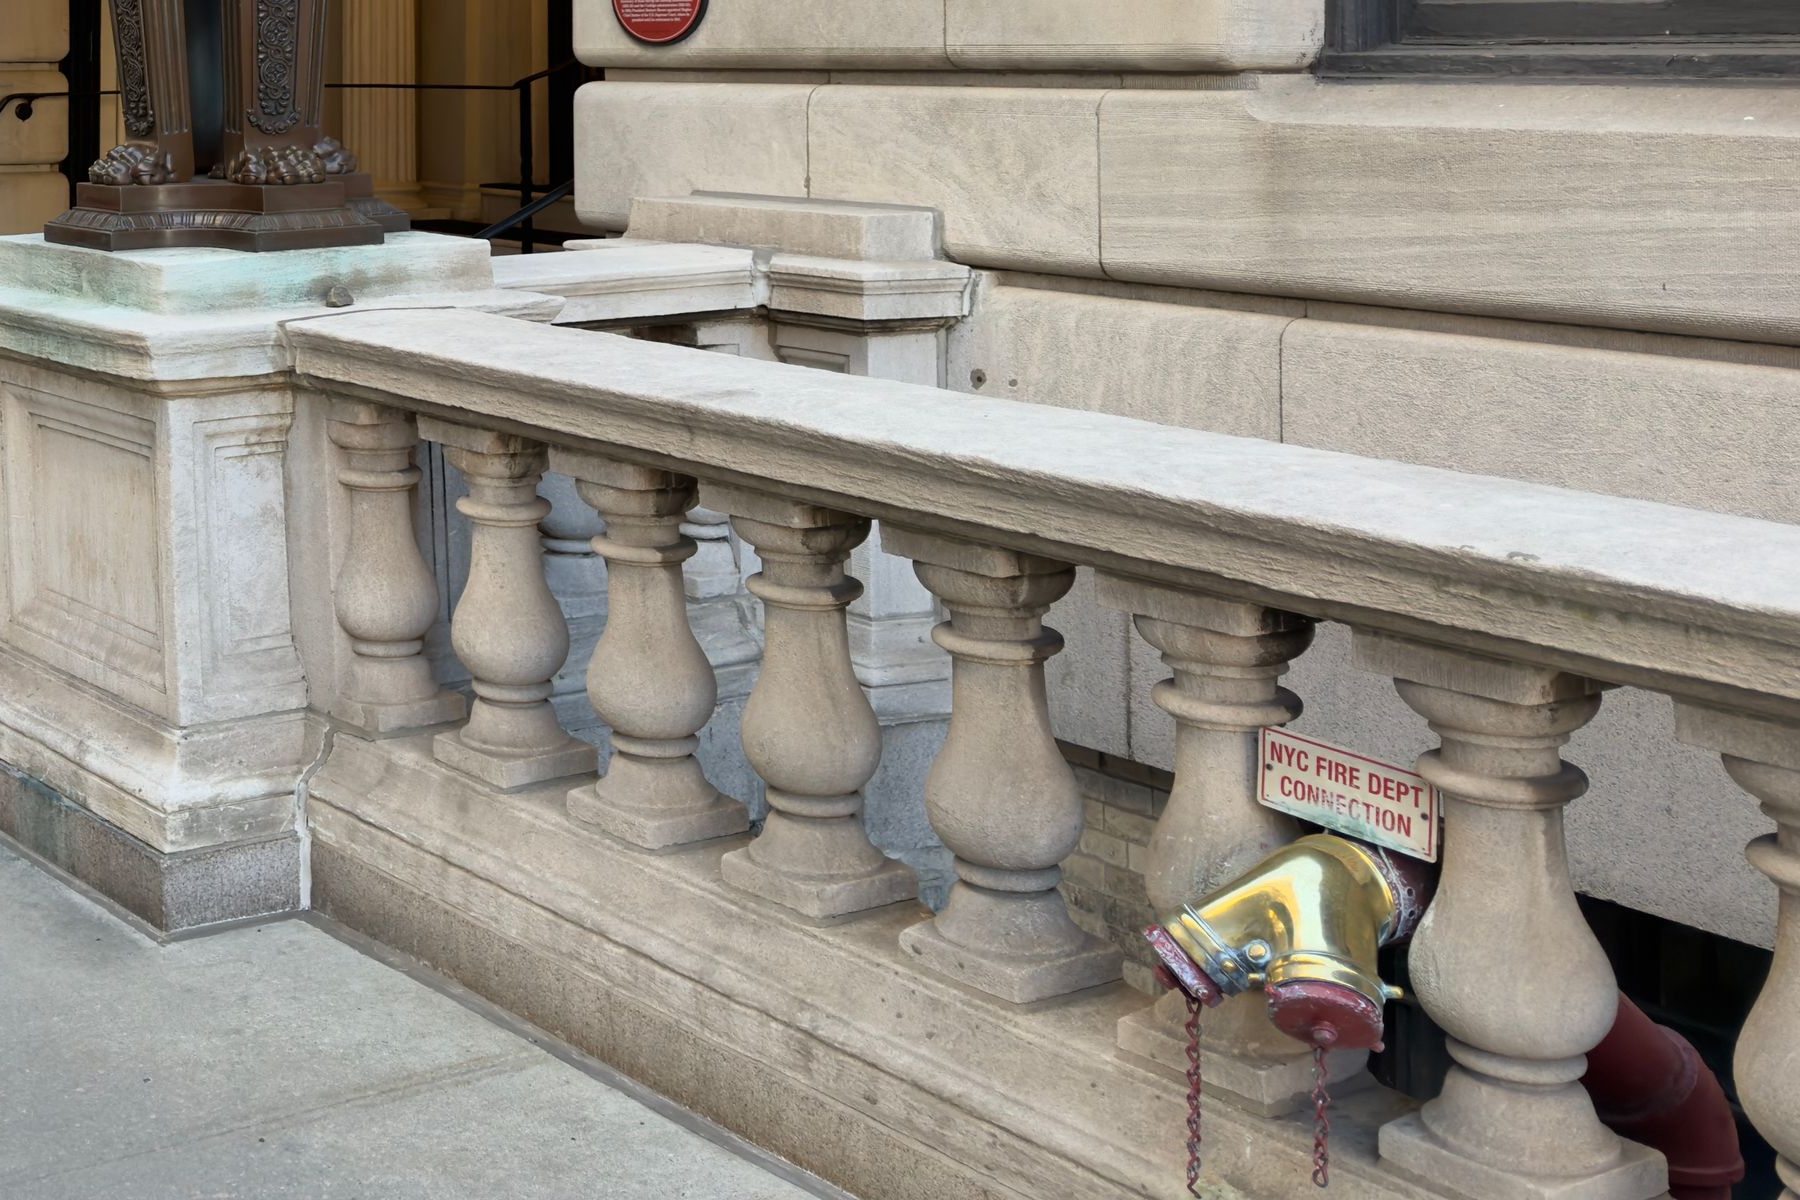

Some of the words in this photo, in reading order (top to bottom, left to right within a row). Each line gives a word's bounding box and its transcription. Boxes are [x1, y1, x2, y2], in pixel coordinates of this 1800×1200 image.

[1270, 741, 1309, 772] NYC
[1316, 756, 1361, 790] FIRE
[1368, 772, 1425, 808] DEPT
[1280, 775, 1412, 838] CONNECTION
